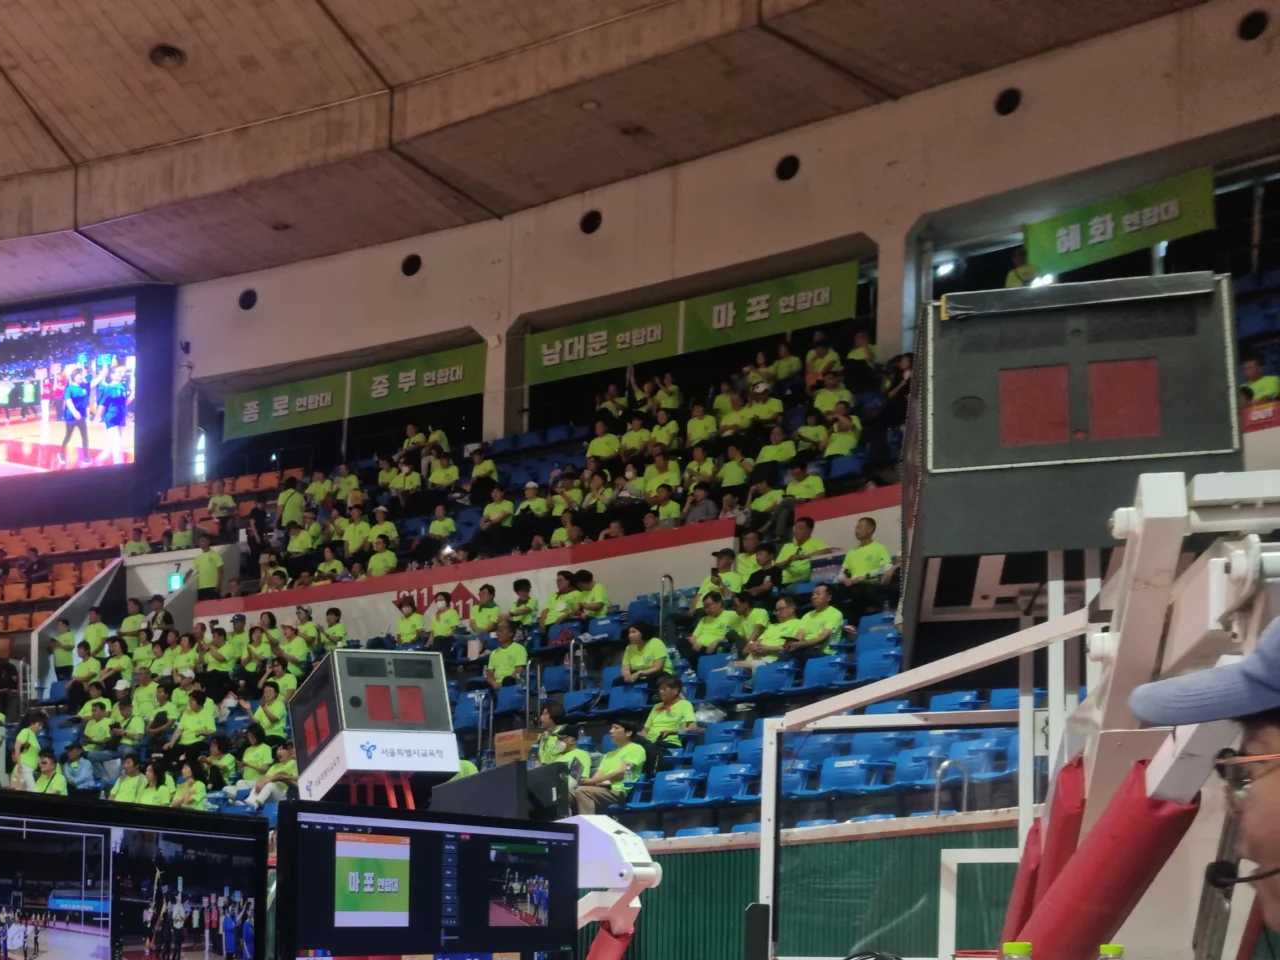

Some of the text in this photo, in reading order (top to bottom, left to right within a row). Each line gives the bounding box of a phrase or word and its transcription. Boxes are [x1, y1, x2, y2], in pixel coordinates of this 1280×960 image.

[712, 286, 831, 329] 마포 연합대
[541, 324, 662, 367] 남대문 연합대
[371, 364, 464, 398] 중부 연합대
[243, 392, 332, 423] 종로 연합대
[174, 563, 181, 573] 7
[381, 748, 444, 759] 서울특별시교육청
